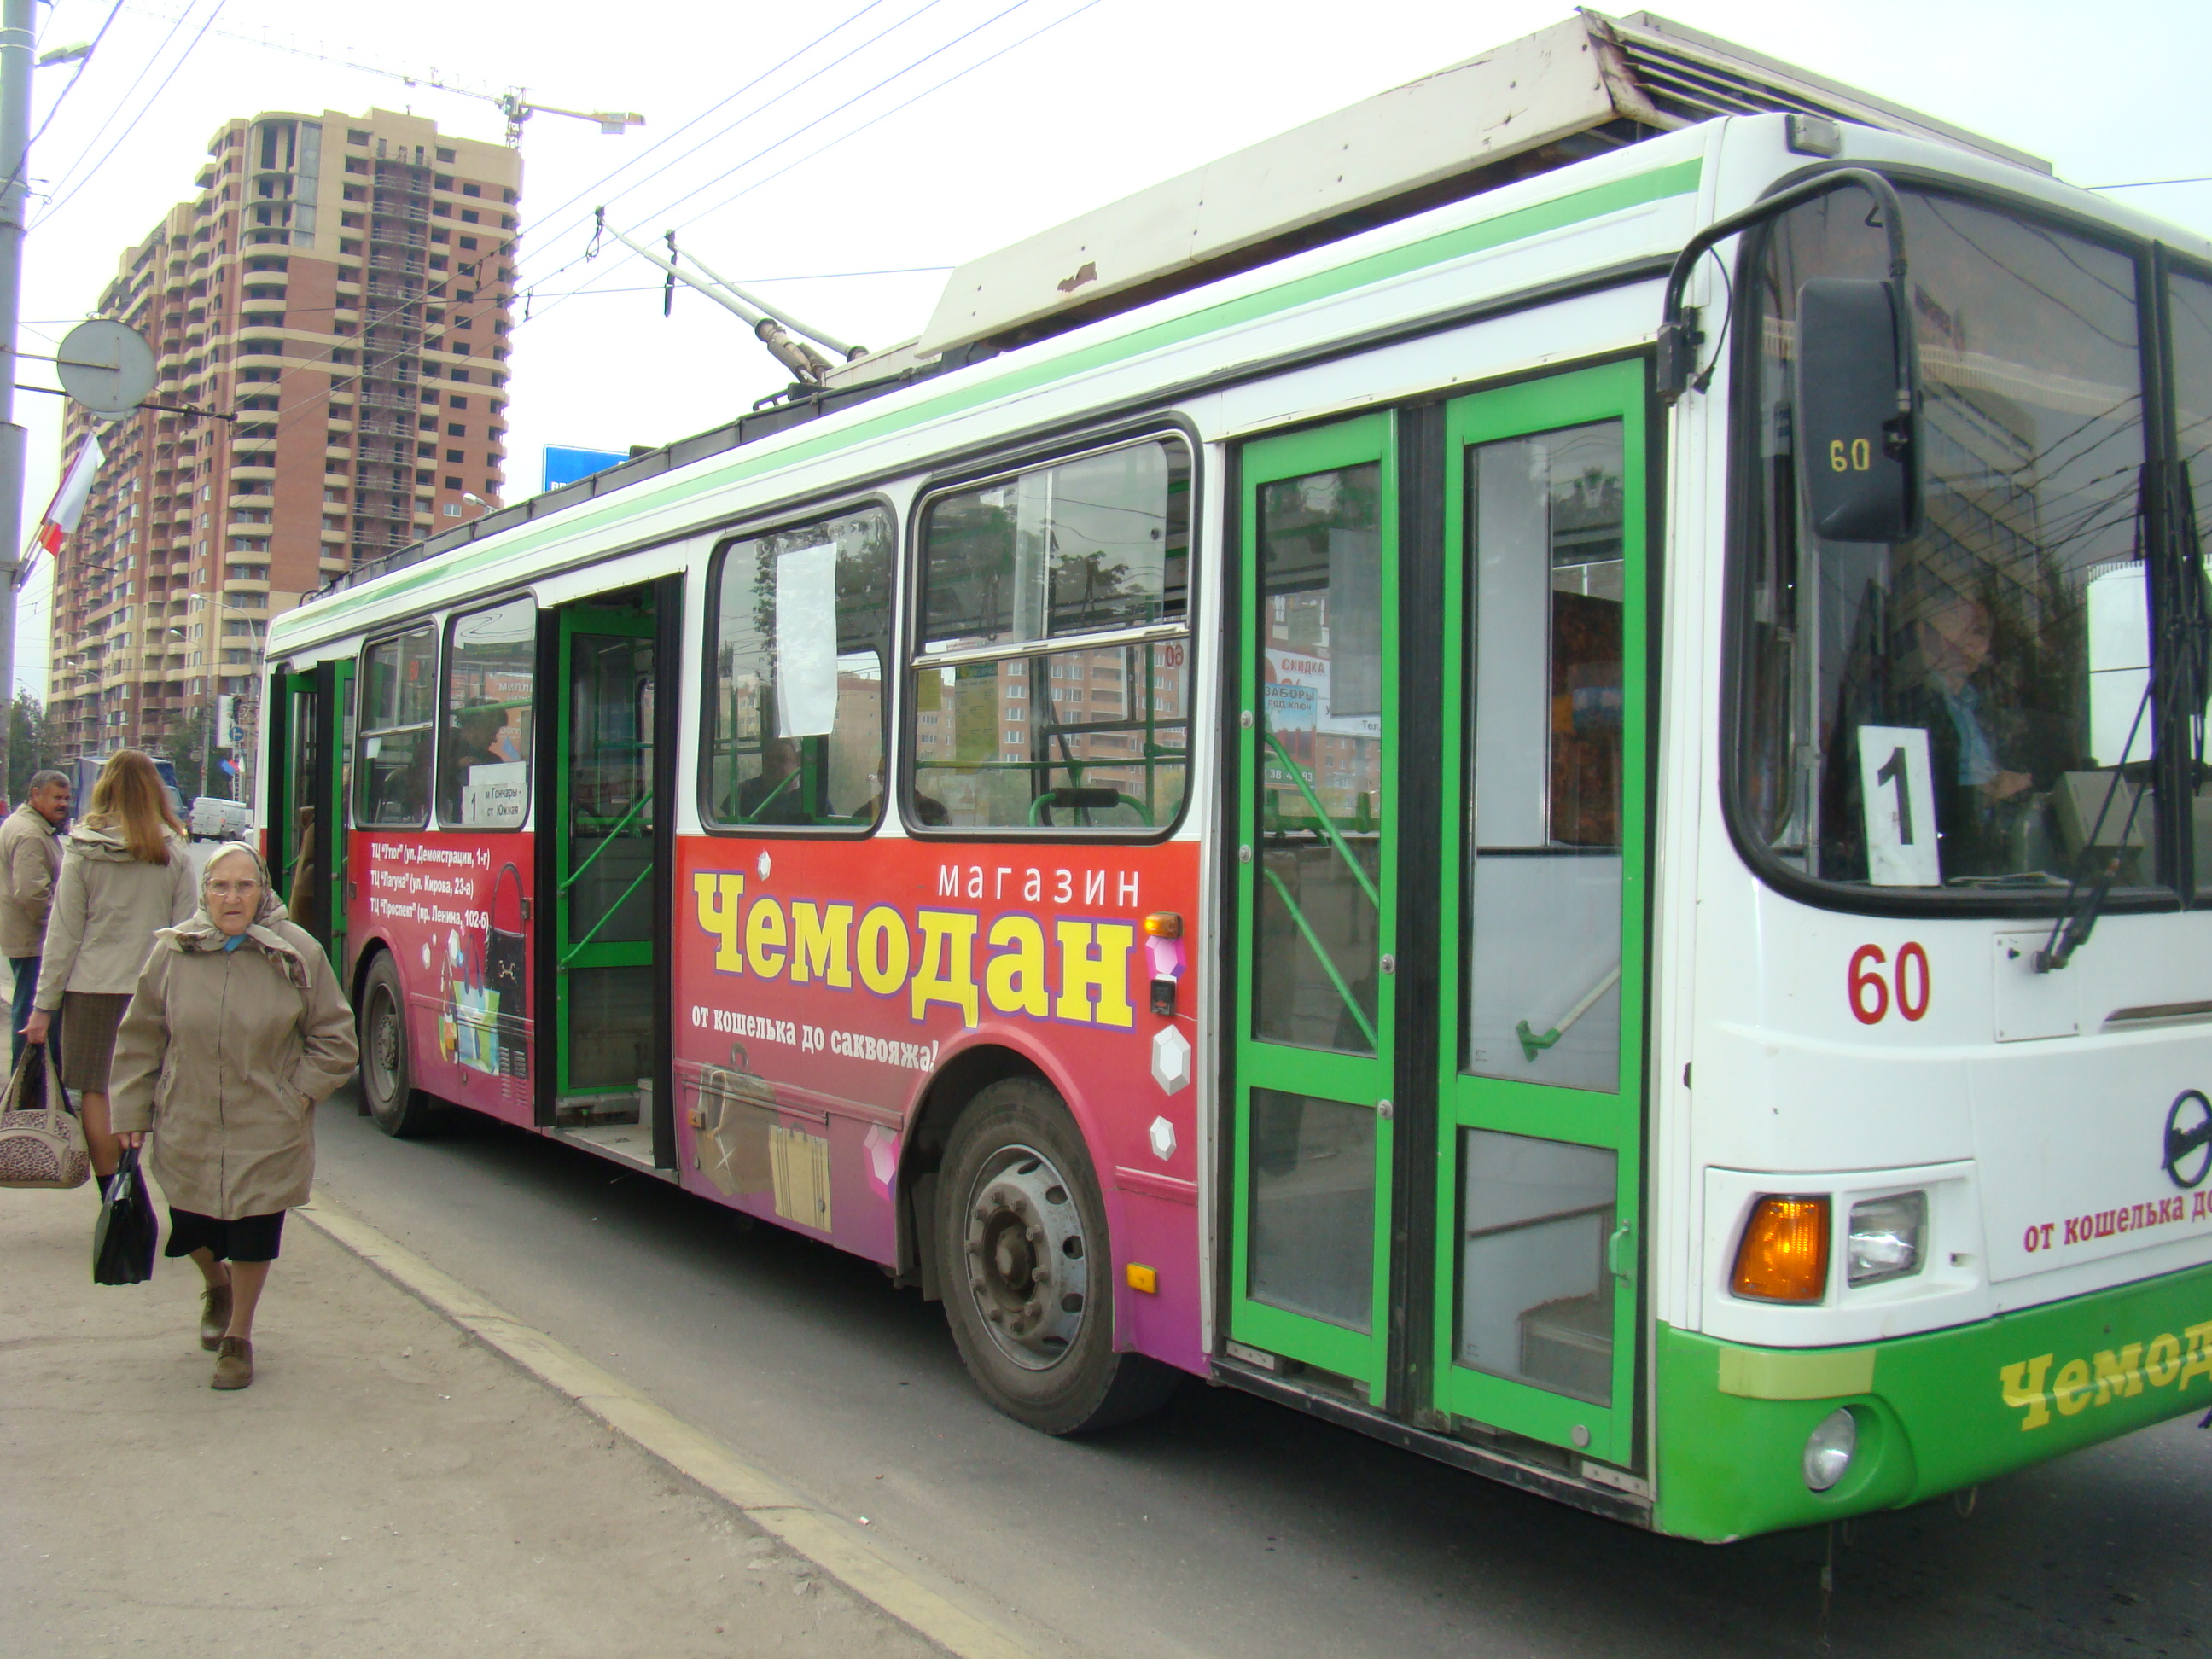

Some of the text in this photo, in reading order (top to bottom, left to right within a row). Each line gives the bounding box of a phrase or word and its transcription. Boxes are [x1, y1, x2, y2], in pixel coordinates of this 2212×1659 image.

[1830, 438, 1870, 472] 60
[1281, 658, 1324, 675] СКИДКА
[1265, 686, 1314, 701] ЗАБОРЫ
[1268, 699, 1312, 710] под ключ
[1270, 769, 1282, 780] 38
[471, 792, 477, 822] 1
[492, 787, 518, 803] Гончары
[1877, 747, 1914, 845] 1
[497, 803, 519, 818] Южная
[371, 843, 381, 861] ТЦ
[404, 844, 416, 864] (ул.
[416, 845, 474, 869] Демонстрации,
[476, 847, 491, 870] 1-г)
[370, 870, 381, 888] ТЦ
[410, 873, 423, 894] (ул.
[424, 875, 453, 897] Кирова,
[454, 877, 474, 900] 23-а)
[939, 864, 1139, 907] магазин
[370, 897, 380, 916] ТЦ
[417, 903, 431, 923] (пр.
[432, 905, 463, 928] Ленина,
[464, 910, 490, 934] 102-б)
[692, 869, 1137, 1034] Чемодан
[1848, 941, 1930, 1025] 60
[692, 1005, 940, 1073] от кошелька до саквояжа!
[2023, 1223, 2054, 1253] от
[2064, 1195, 2184, 1245] кошелька
